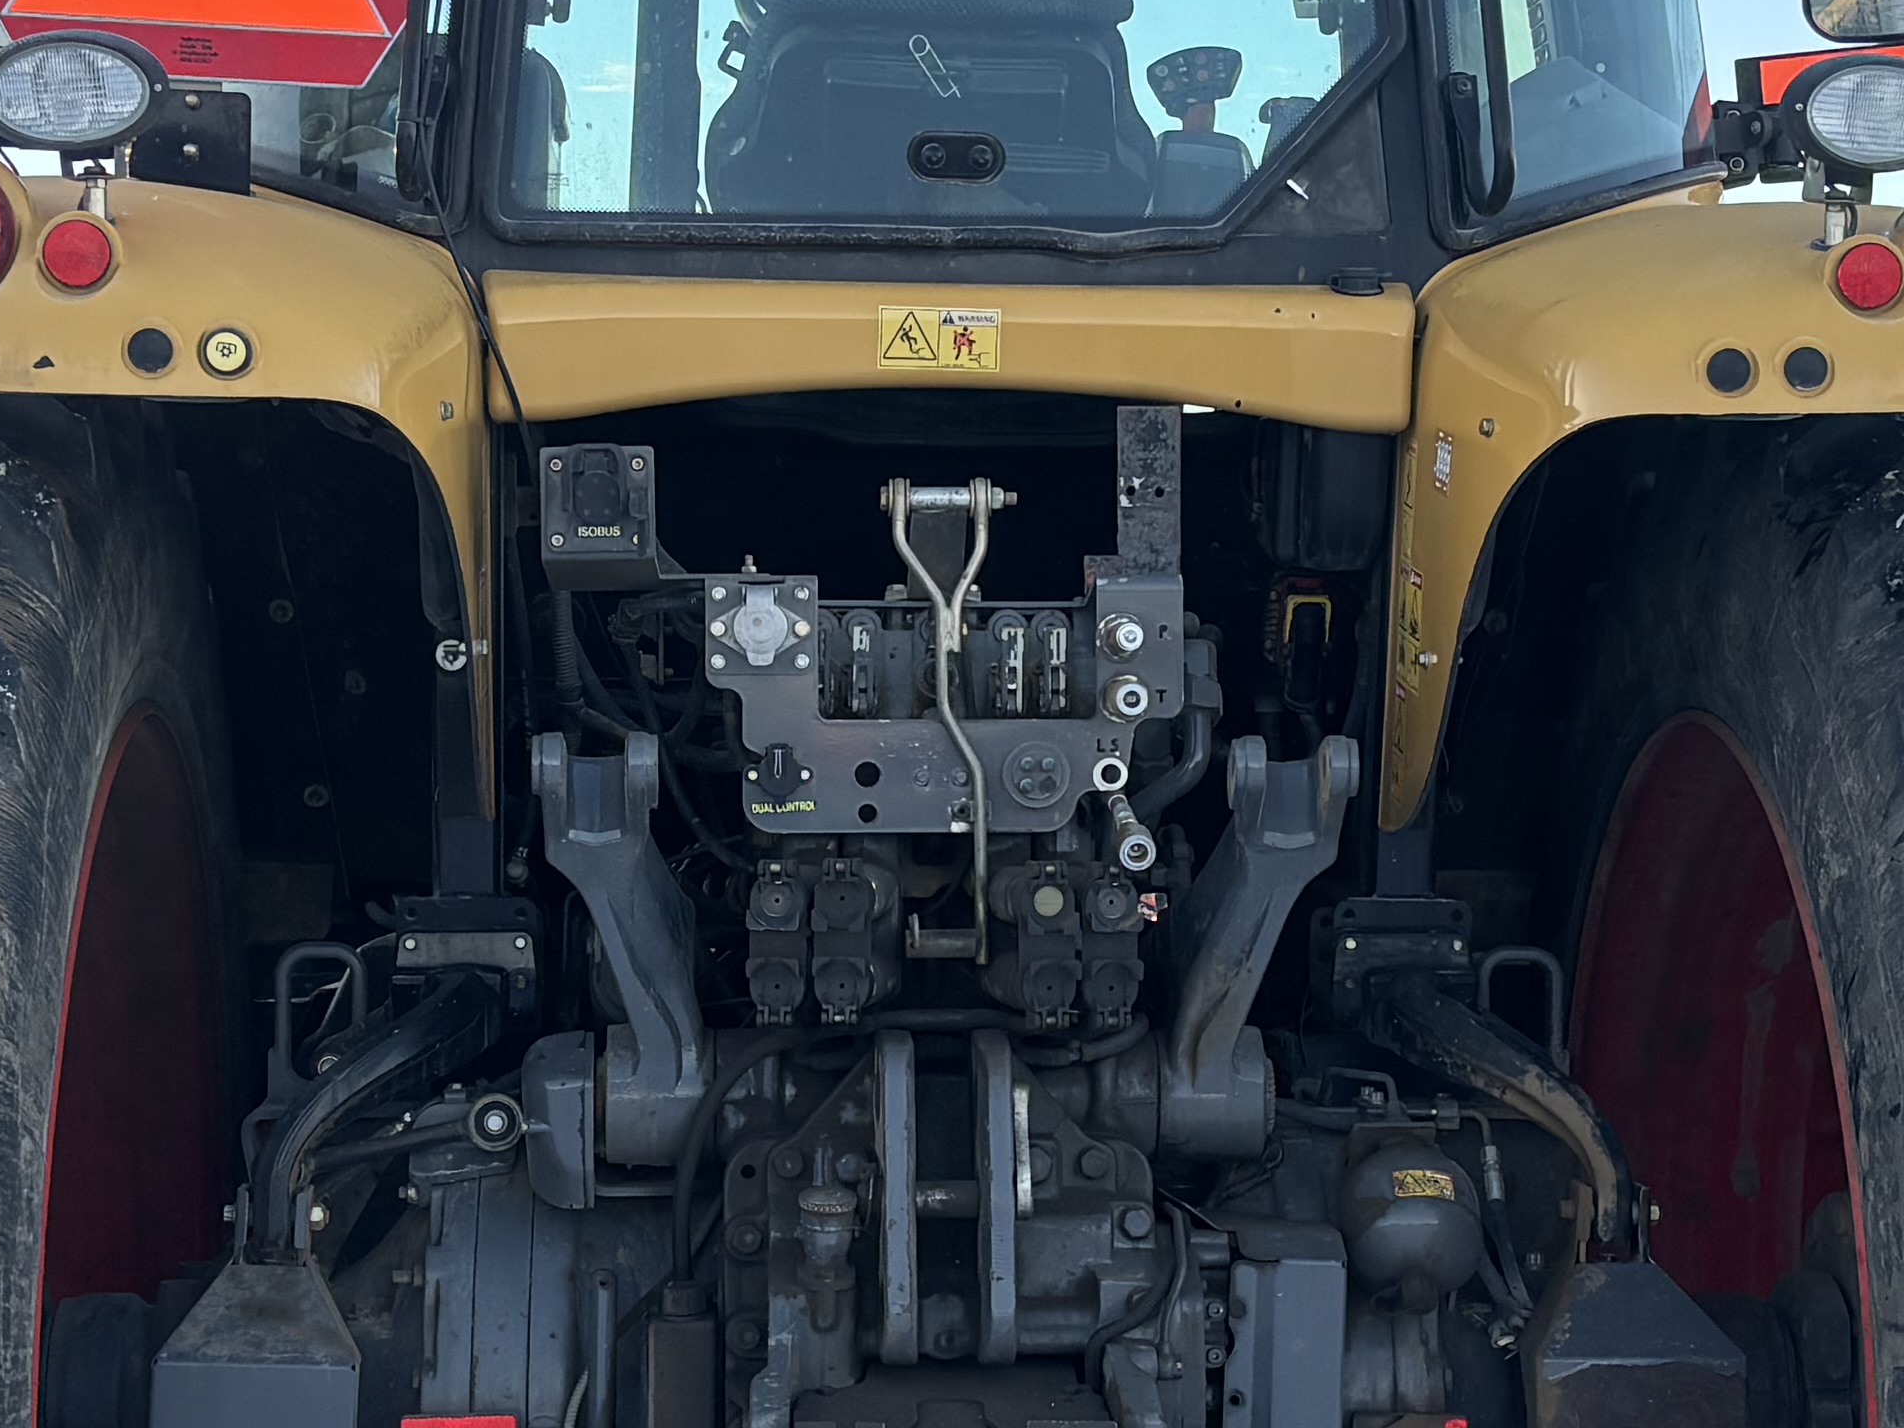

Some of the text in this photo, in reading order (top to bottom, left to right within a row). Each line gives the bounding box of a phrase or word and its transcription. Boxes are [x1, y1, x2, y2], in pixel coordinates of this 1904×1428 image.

[578, 526, 621, 537] ISOBUS
[1155, 689, 1168, 703] T
[751, 803, 775, 814] DUAL
